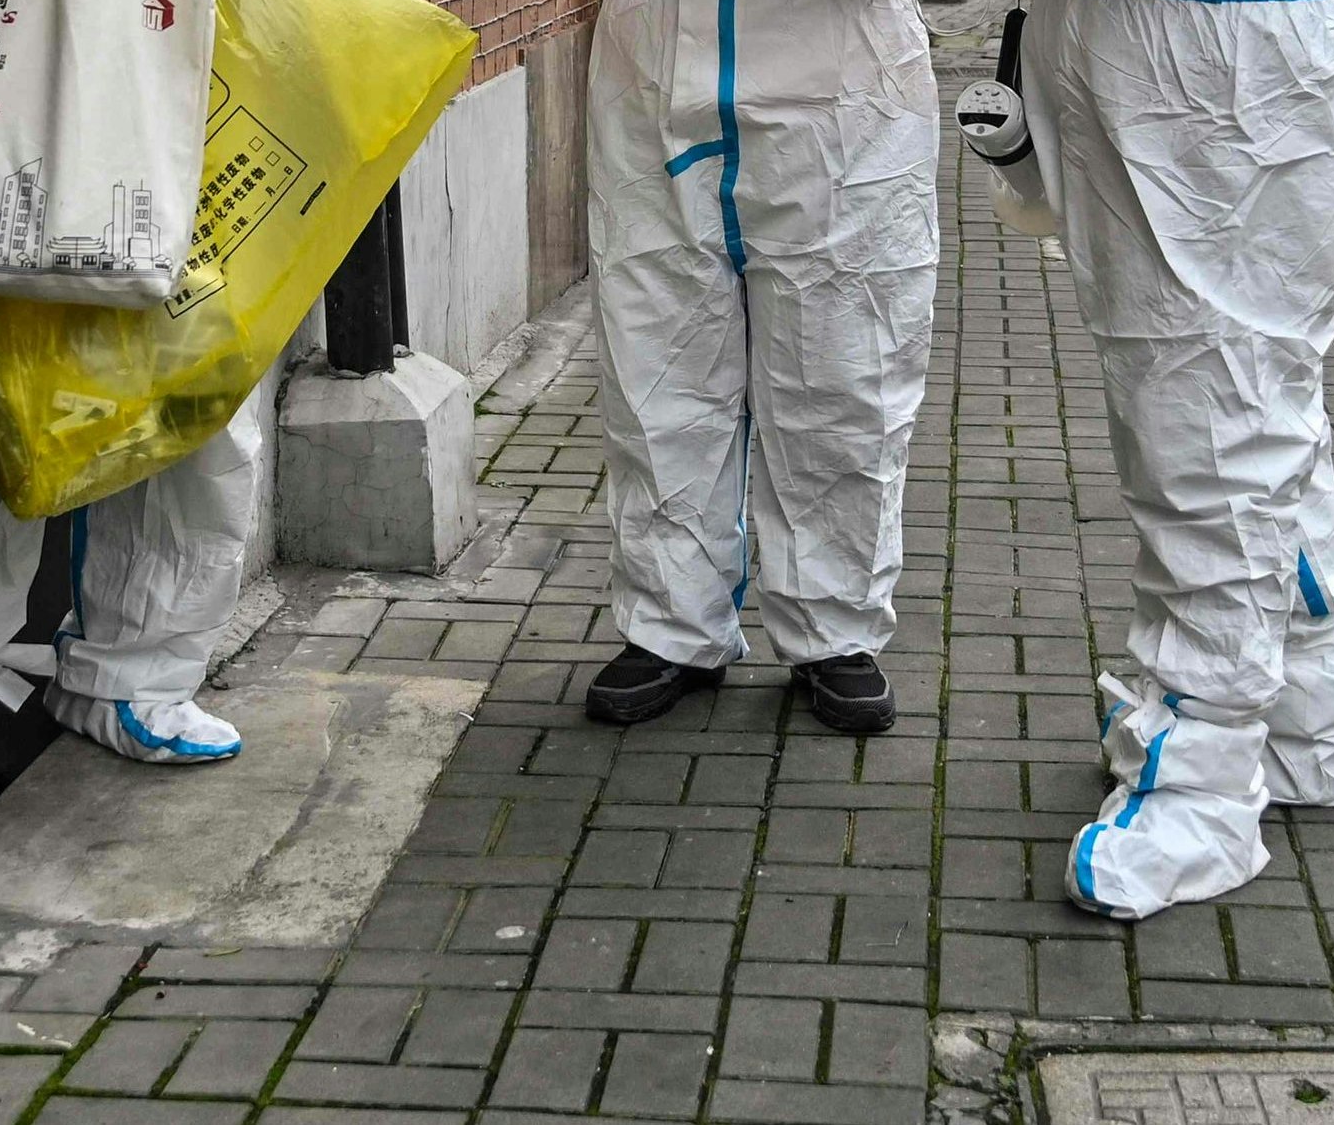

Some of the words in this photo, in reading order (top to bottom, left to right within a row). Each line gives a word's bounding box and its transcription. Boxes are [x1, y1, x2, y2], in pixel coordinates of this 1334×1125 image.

[214, 166, 266, 221] 化学性废物
